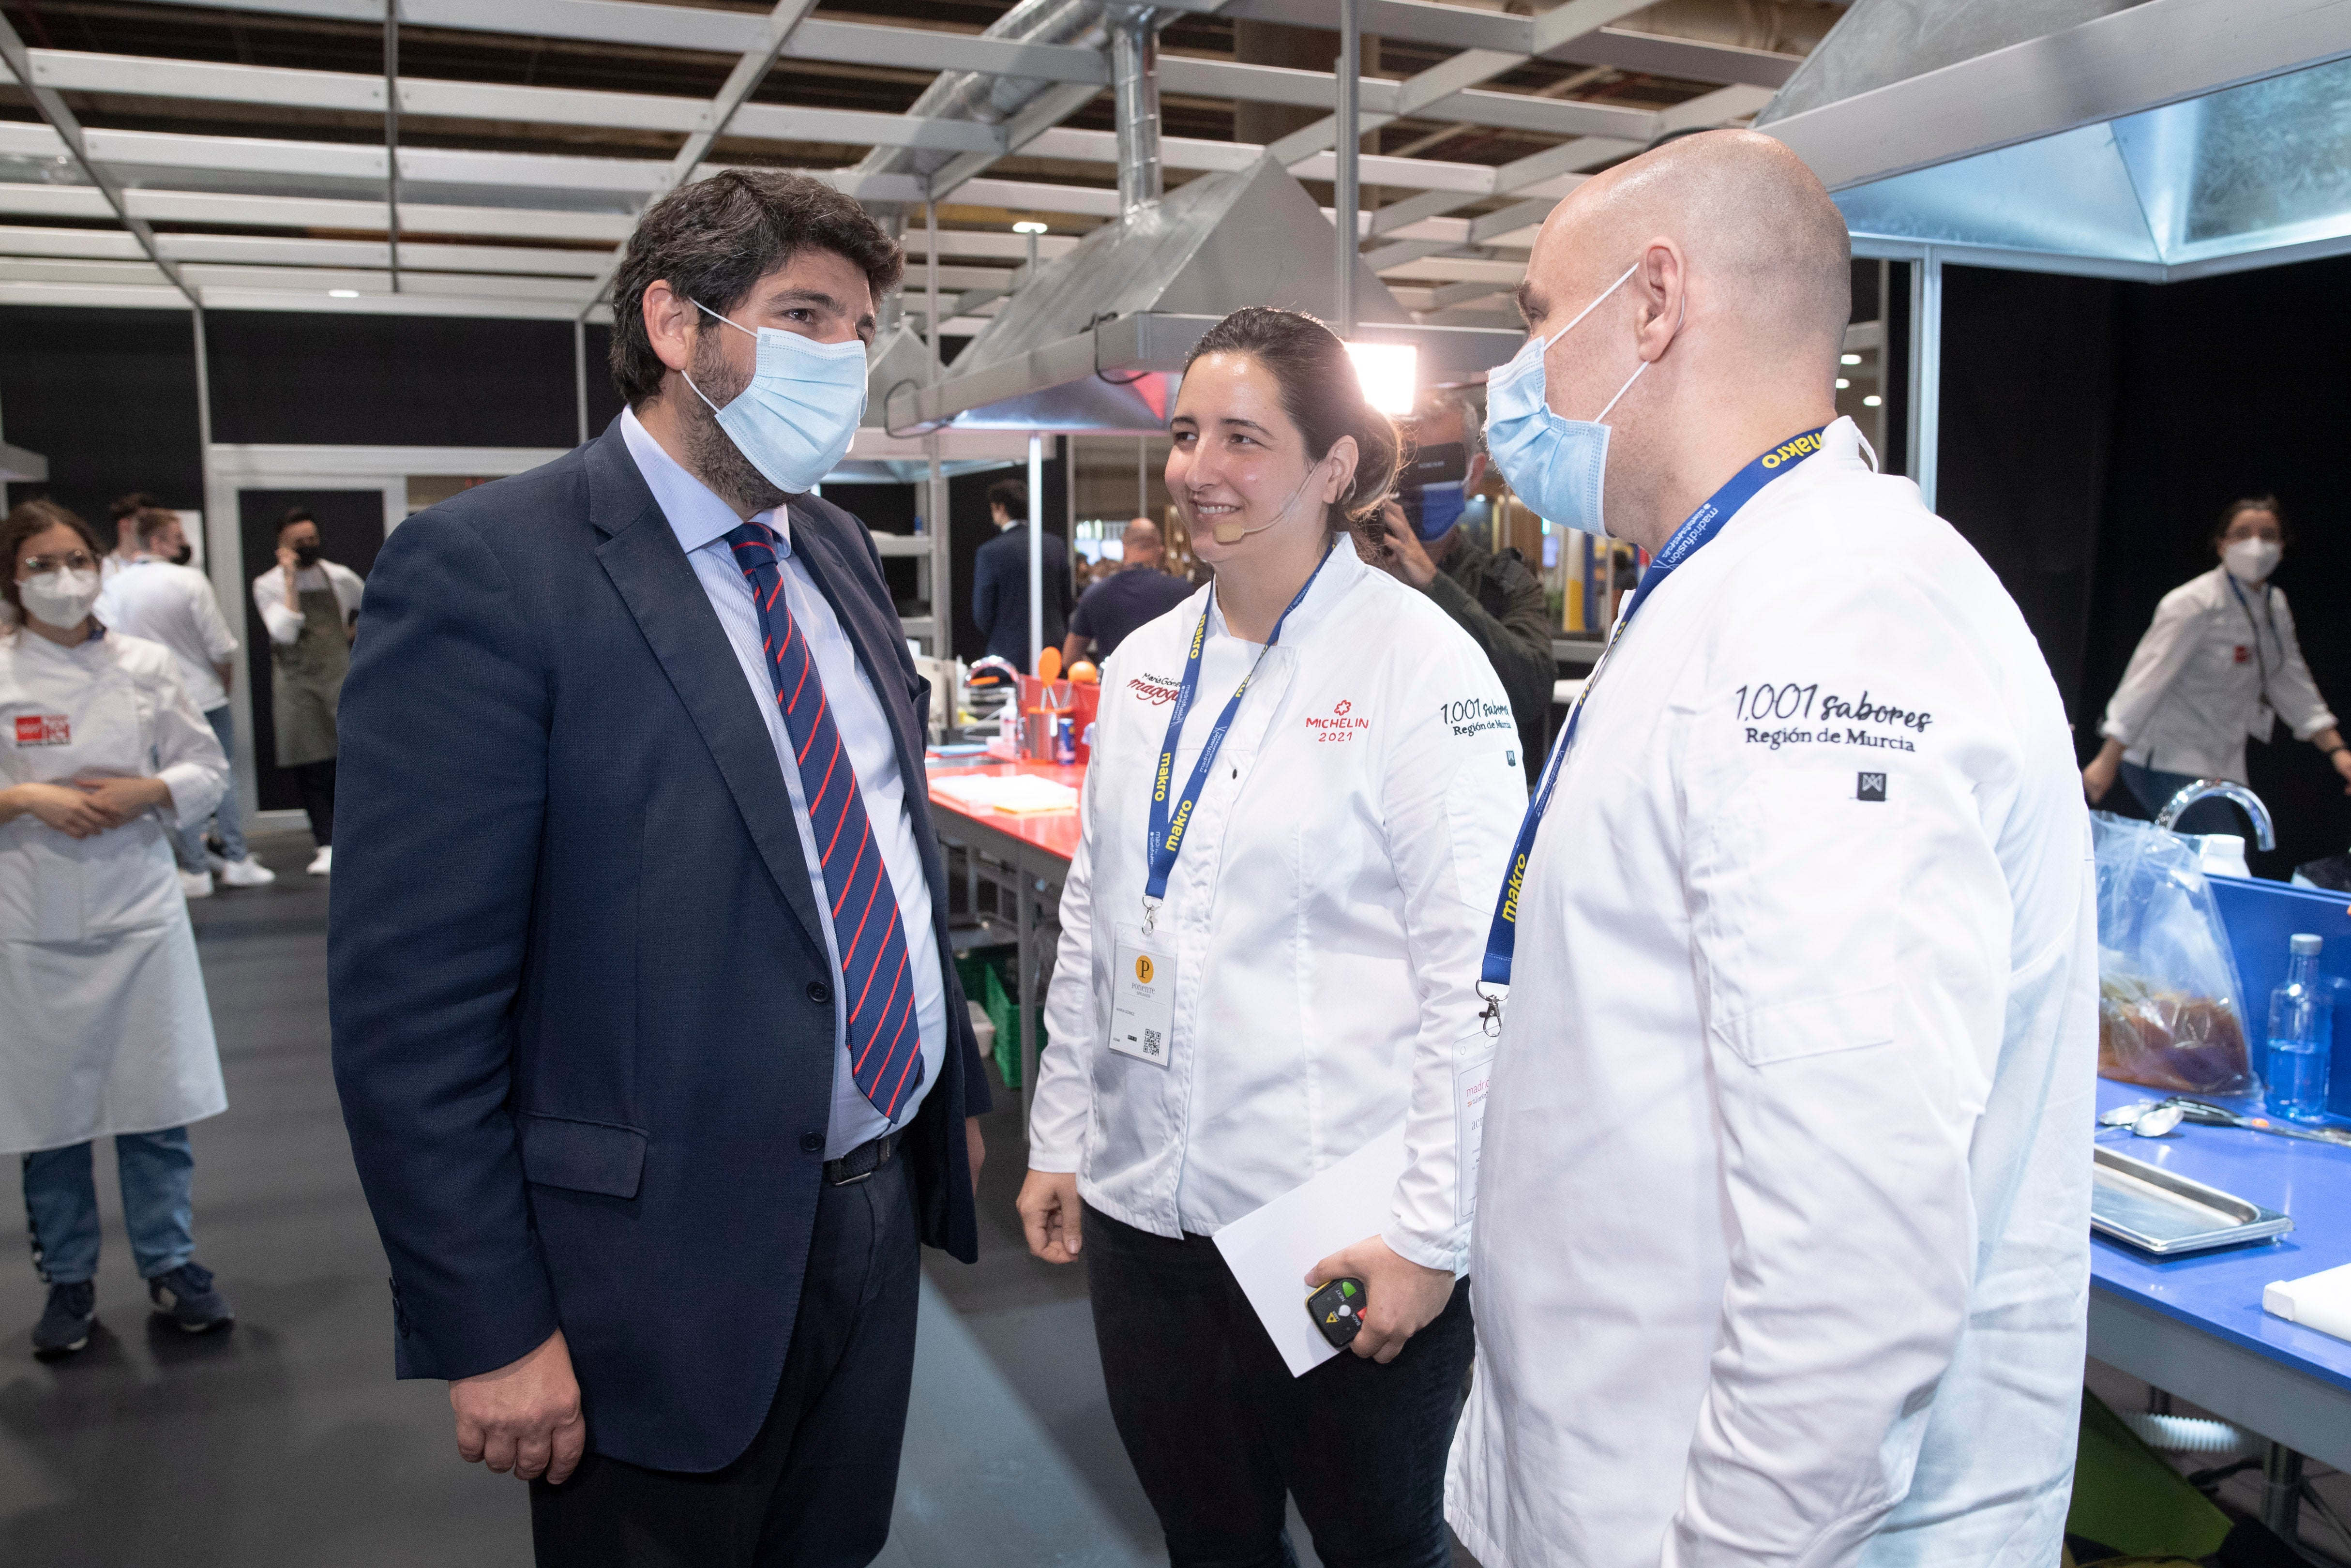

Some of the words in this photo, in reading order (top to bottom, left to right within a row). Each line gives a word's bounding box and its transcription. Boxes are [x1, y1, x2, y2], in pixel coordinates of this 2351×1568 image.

[1190, 614, 1206, 659] makro
[1306, 718, 1369, 729] MICHELIN
[1441, 698, 1481, 724] 1.001
[1821, 691, 1933, 732] sabores
[1318, 732, 1352, 742] 2021
[1453, 722, 1486, 737] Región
[1746, 727, 1811, 750] Región
[1817, 727, 1840, 743] de
[1845, 728, 1915, 752] Murcia
[1155, 753, 1171, 801] makro
[1165, 800, 1192, 852] makro
[1502, 853, 1525, 922] makro
[1336, 1289, 1345, 1301] NEXT
[1351, 1313, 1361, 1326] BACK
